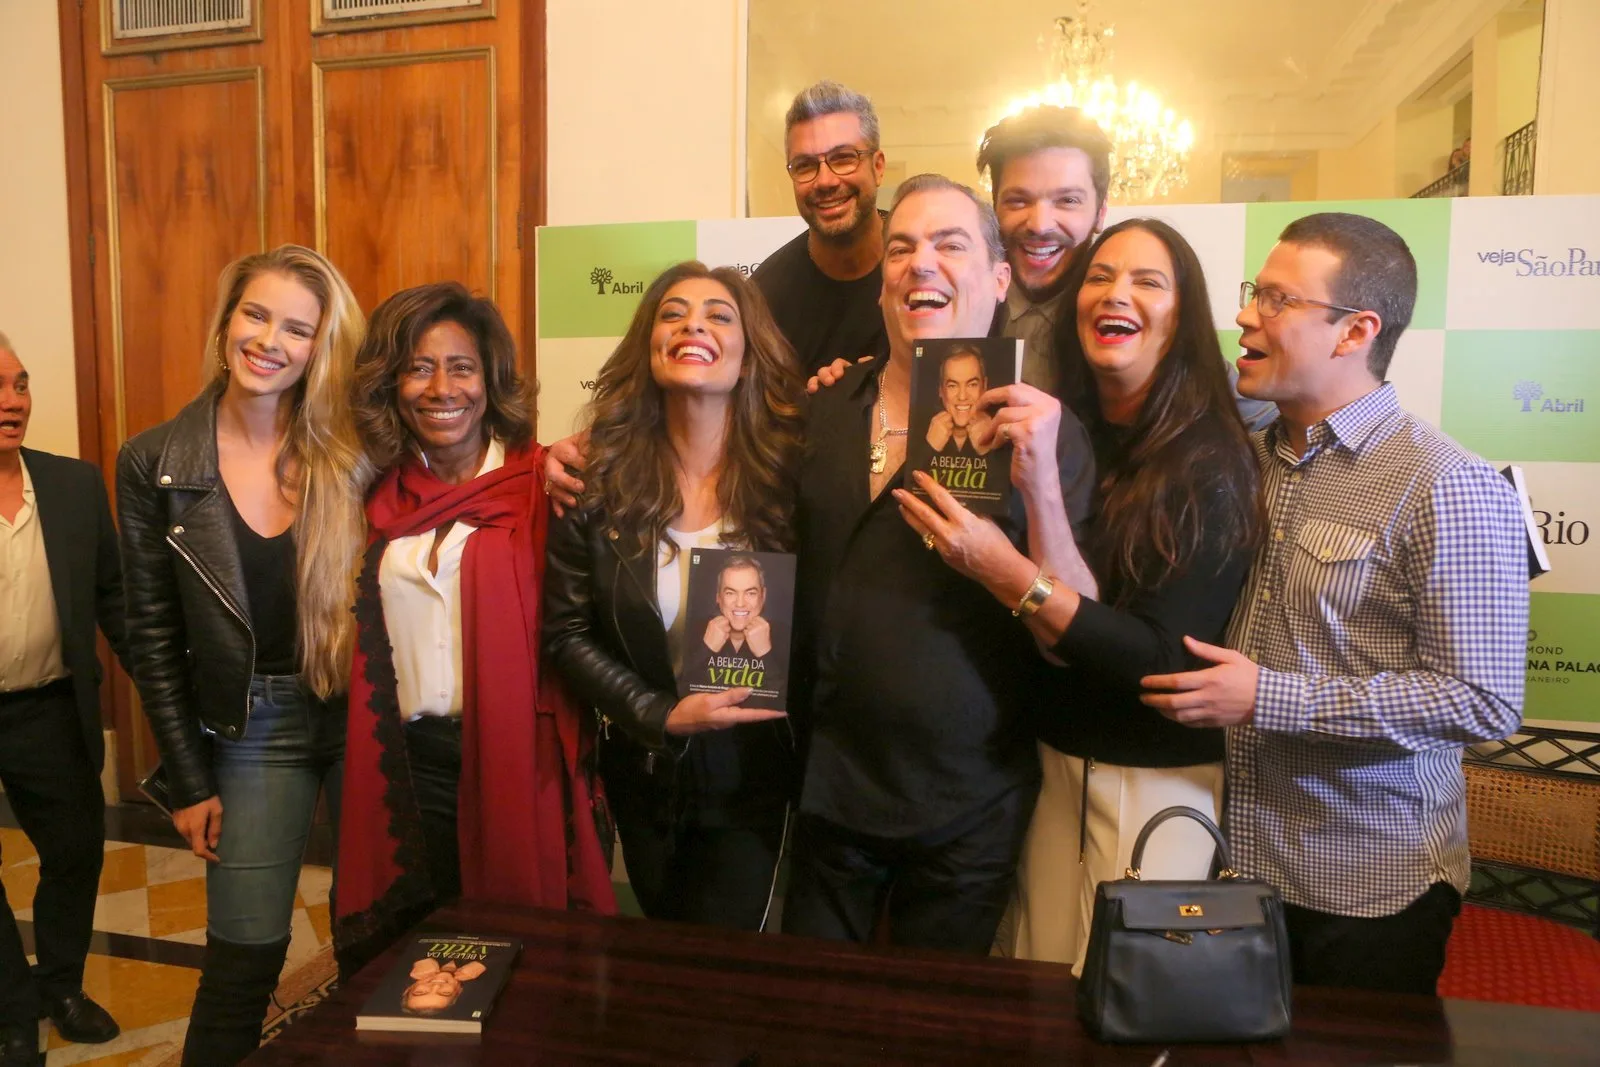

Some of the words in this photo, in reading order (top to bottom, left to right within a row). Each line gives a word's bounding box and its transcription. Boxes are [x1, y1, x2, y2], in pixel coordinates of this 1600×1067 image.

[612, 281, 643, 294] Abril
[1540, 399, 1584, 412] Abril
[930, 456, 938, 467] A
[939, 456, 972, 469] BELEZA
[973, 457, 988, 470] DA
[930, 463, 987, 489] vida
[1532, 510, 1589, 546] Rio
[1526, 645, 1564, 655] MOND
[708, 656, 716, 667] A
[716, 656, 750, 669] BELEZA
[751, 658, 765, 670] DA
[1556, 660, 1600, 674] PALA
[708, 663, 764, 688] vida
